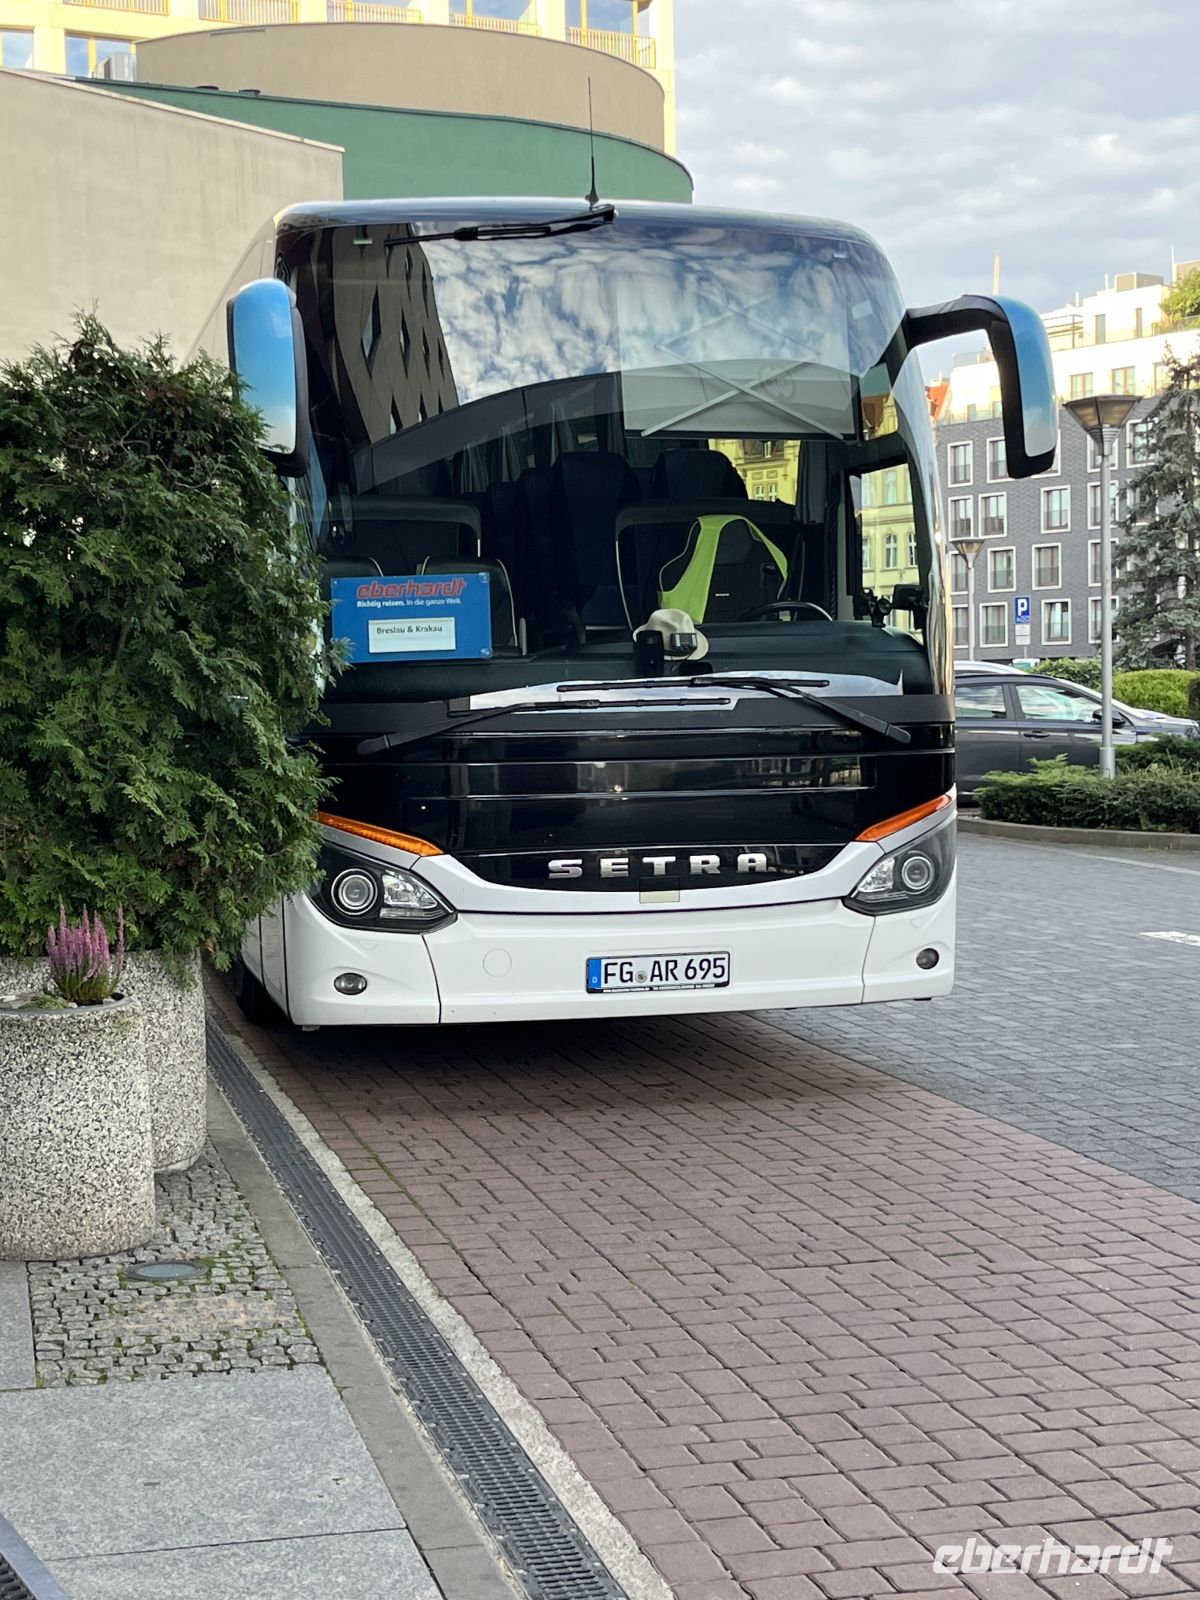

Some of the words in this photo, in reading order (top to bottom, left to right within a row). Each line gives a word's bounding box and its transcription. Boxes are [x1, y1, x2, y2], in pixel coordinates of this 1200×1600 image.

[356, 577, 467, 599] eberhardt
[356, 600, 381, 608] Richtig
[382, 599, 405, 607] reisen.
[414, 598, 424, 606] die
[446, 597, 462, 605] Welt.
[1017, 598, 1028, 616] P
[376, 626, 406, 635] Breslau
[407, 626, 414, 634] &
[415, 625, 443, 633] Krakau
[548, 853, 768, 879] SETRA
[603, 961, 634, 985] FG
[649, 959, 679, 983] AR
[684, 957, 726, 980] 695
